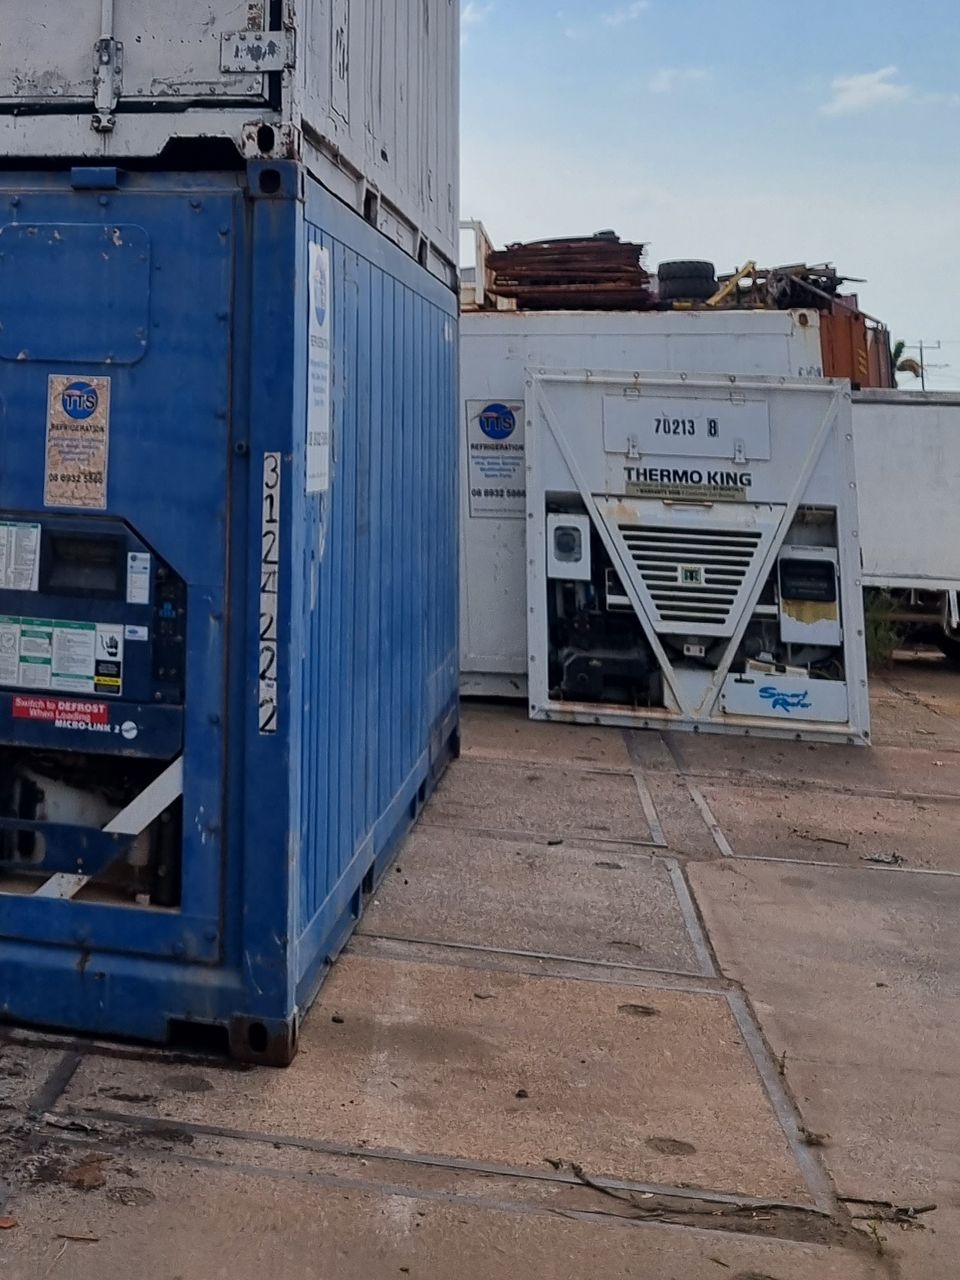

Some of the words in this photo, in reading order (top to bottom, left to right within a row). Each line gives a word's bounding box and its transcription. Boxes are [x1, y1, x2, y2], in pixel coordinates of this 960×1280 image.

[65, 394, 96, 410] TTS
[484, 416, 513, 431] TTS
[654, 418, 696, 436] 70213
[623, 466, 703, 484] THERMO
[707, 471, 752, 487] KING
[15, 697, 46, 709] Switch
[46, 700, 56, 710] to
[57, 701, 106, 713] DEFROST
[29, 707, 54, 719] When
[55, 710, 91, 722] Loading
[114, 724, 120, 734] 2
